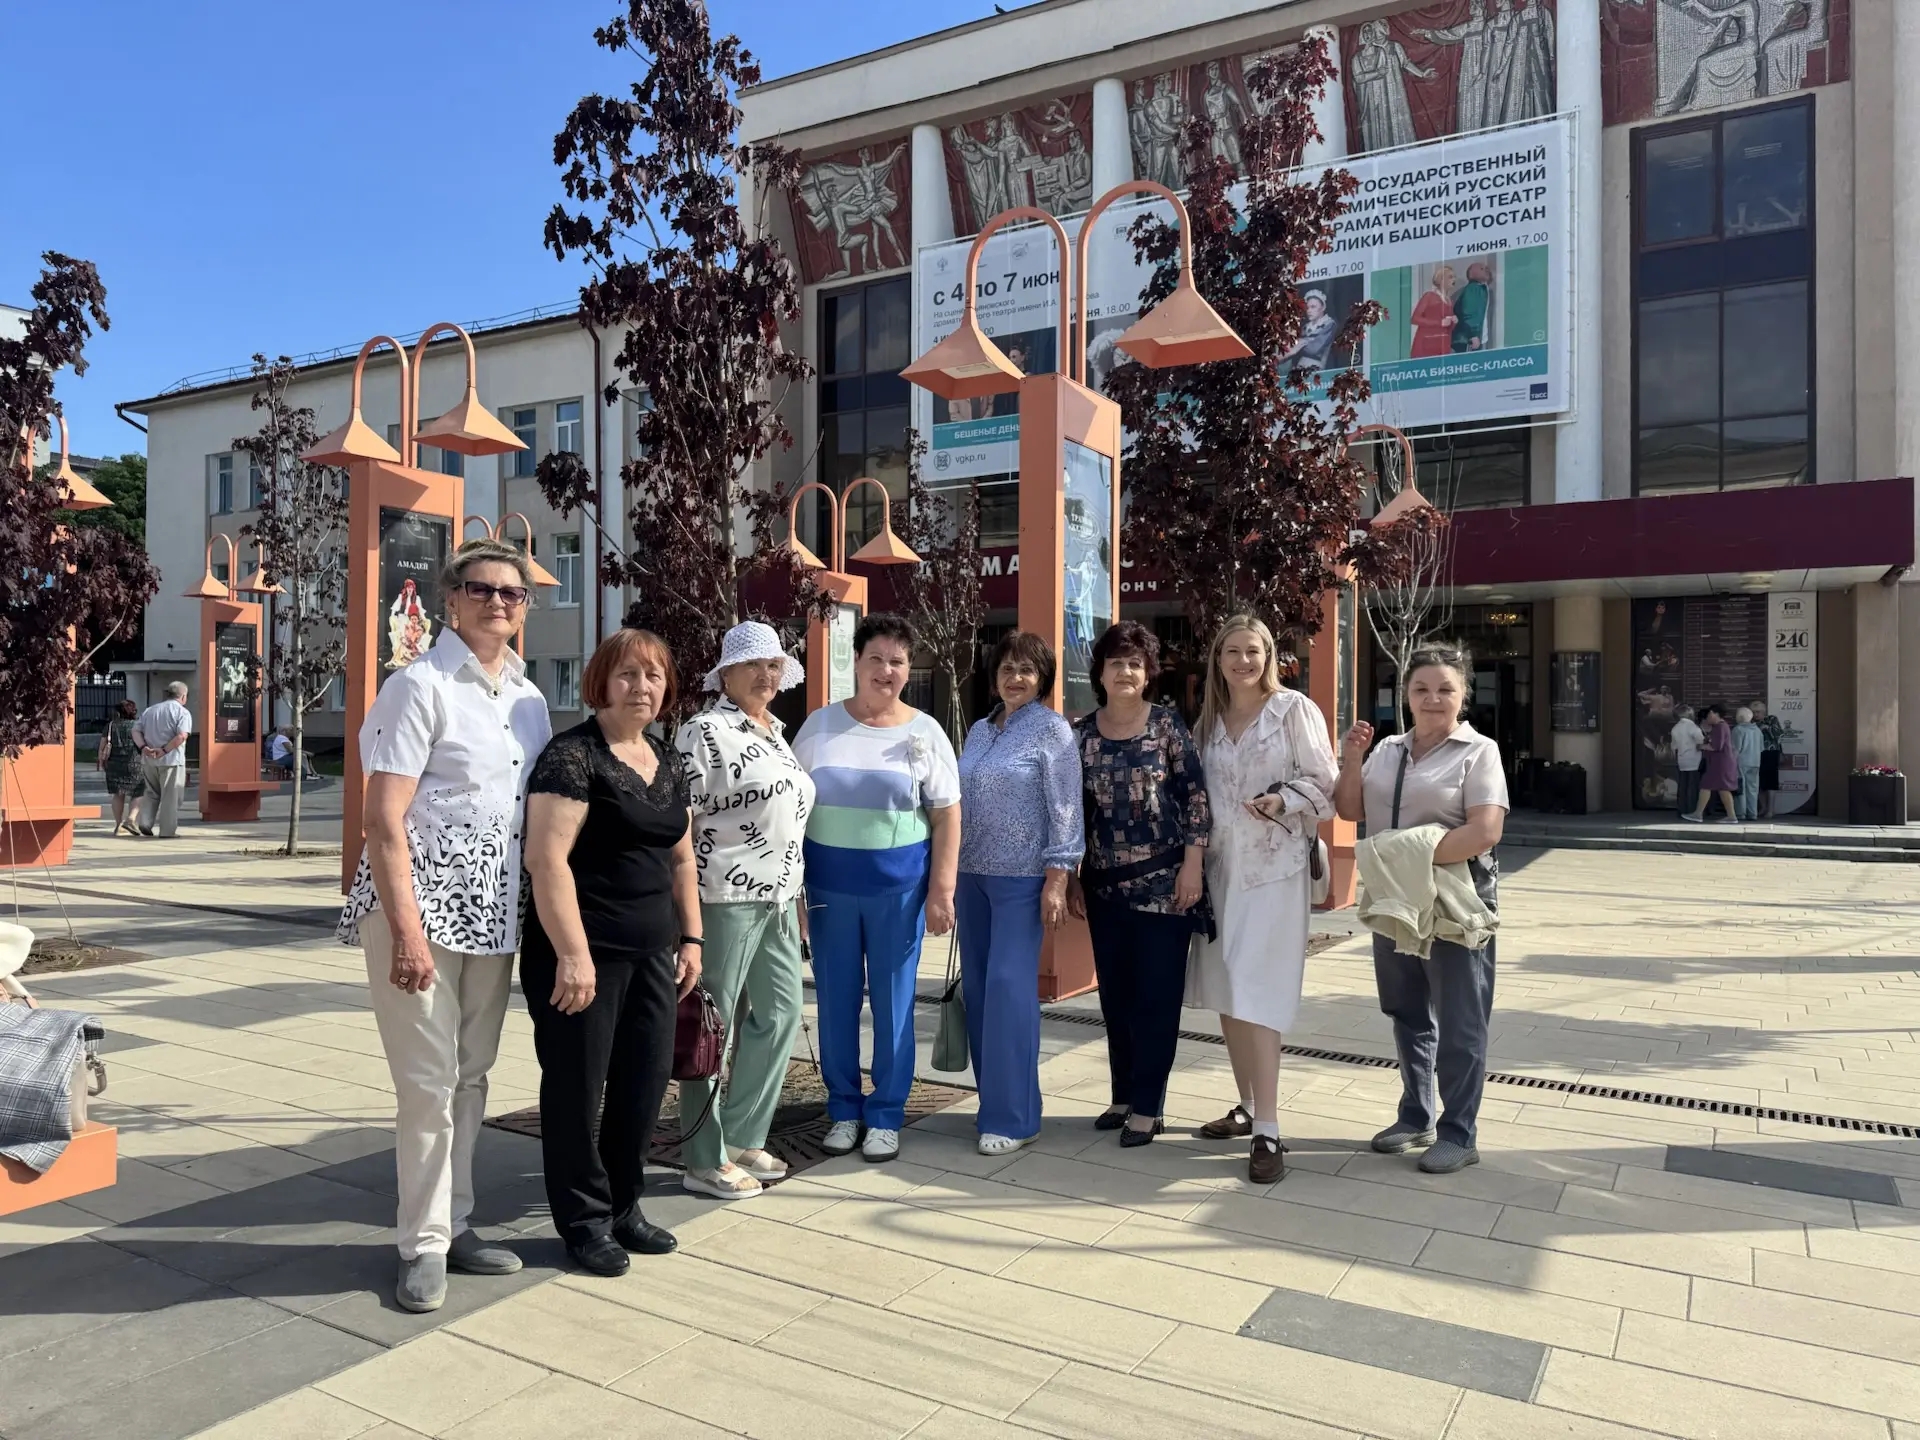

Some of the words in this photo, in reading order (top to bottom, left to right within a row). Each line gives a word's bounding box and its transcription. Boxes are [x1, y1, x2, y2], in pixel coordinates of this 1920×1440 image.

[1349, 183, 1449, 213] МИЧЕСКИЙ
[1455, 166, 1546, 196] РУССКИЙ
[1489, 186, 1547, 209] ТЕАТР
[1389, 205, 1546, 242] БАШКОРТОСТАН
[1456, 245, 1463, 254] 7
[1516, 232, 1548, 245] 17.00
[1336, 261, 1364, 274] 17.00
[951, 283, 964, 301] 4
[1003, 272, 1018, 292] 7
[1022, 270, 1060, 289] июн
[1106, 302, 1131, 314] 18.00
[1381, 368, 1428, 382] ПАЛАТА
[1430, 356, 1534, 377] БИЗНЕС-КЛАССА
[954, 426, 997, 439] БЕШЕНЫЕ
[998, 424, 1020, 434] ДЕНЬ
[955, 453, 986, 464] vgkp.ru
[397, 560, 429, 570] АМАДЕЙ
[1776, 631, 1808, 648] 240
[1781, 701, 1803, 710] 2026
[700, 721, 722, 769] living
[728, 743, 769, 780] love
[707, 777, 794, 816] wonderf
[740, 822, 767, 850] like
[725, 864, 774, 897] love
